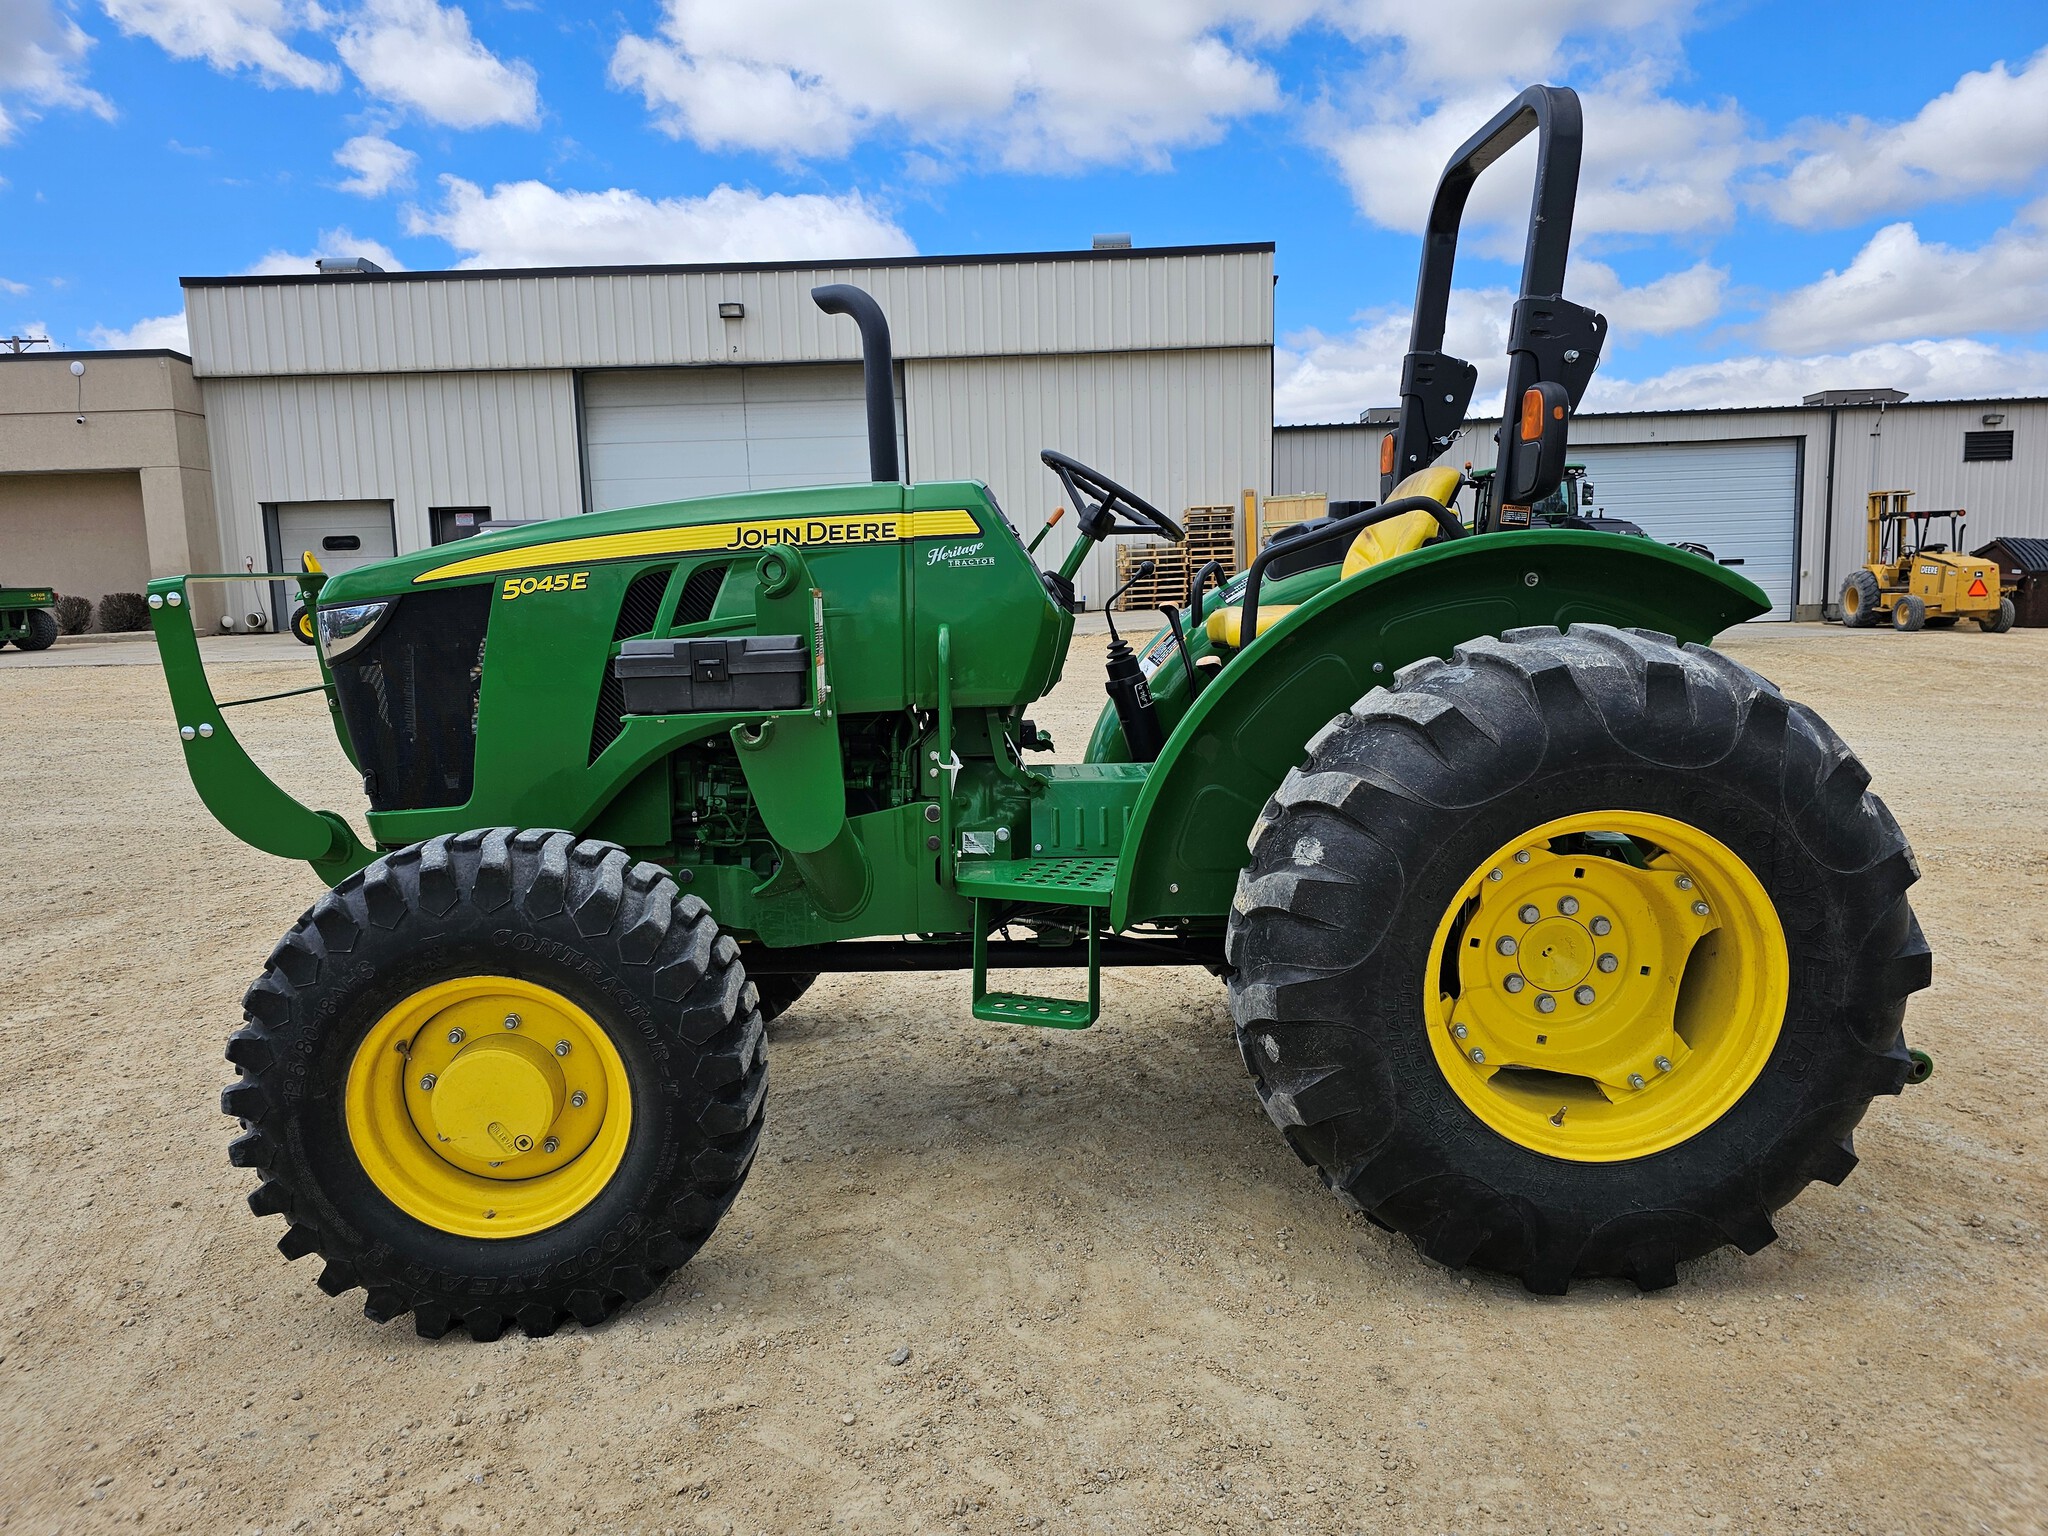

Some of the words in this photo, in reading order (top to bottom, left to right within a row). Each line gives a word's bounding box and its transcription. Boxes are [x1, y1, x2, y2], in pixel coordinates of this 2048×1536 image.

[727, 526, 801, 549] JOHN
[807, 521, 897, 542] DEERE
[926, 542, 984, 566] Heritage
[948, 558, 995, 567] TRACTOR
[1920, 565, 1938, 574] DEERE
[502, 572, 590, 600] 5045E
[1385, 1001, 1456, 1146] INDUSTRIAL
[1407, 1037, 1480, 1147] TRACTOR
